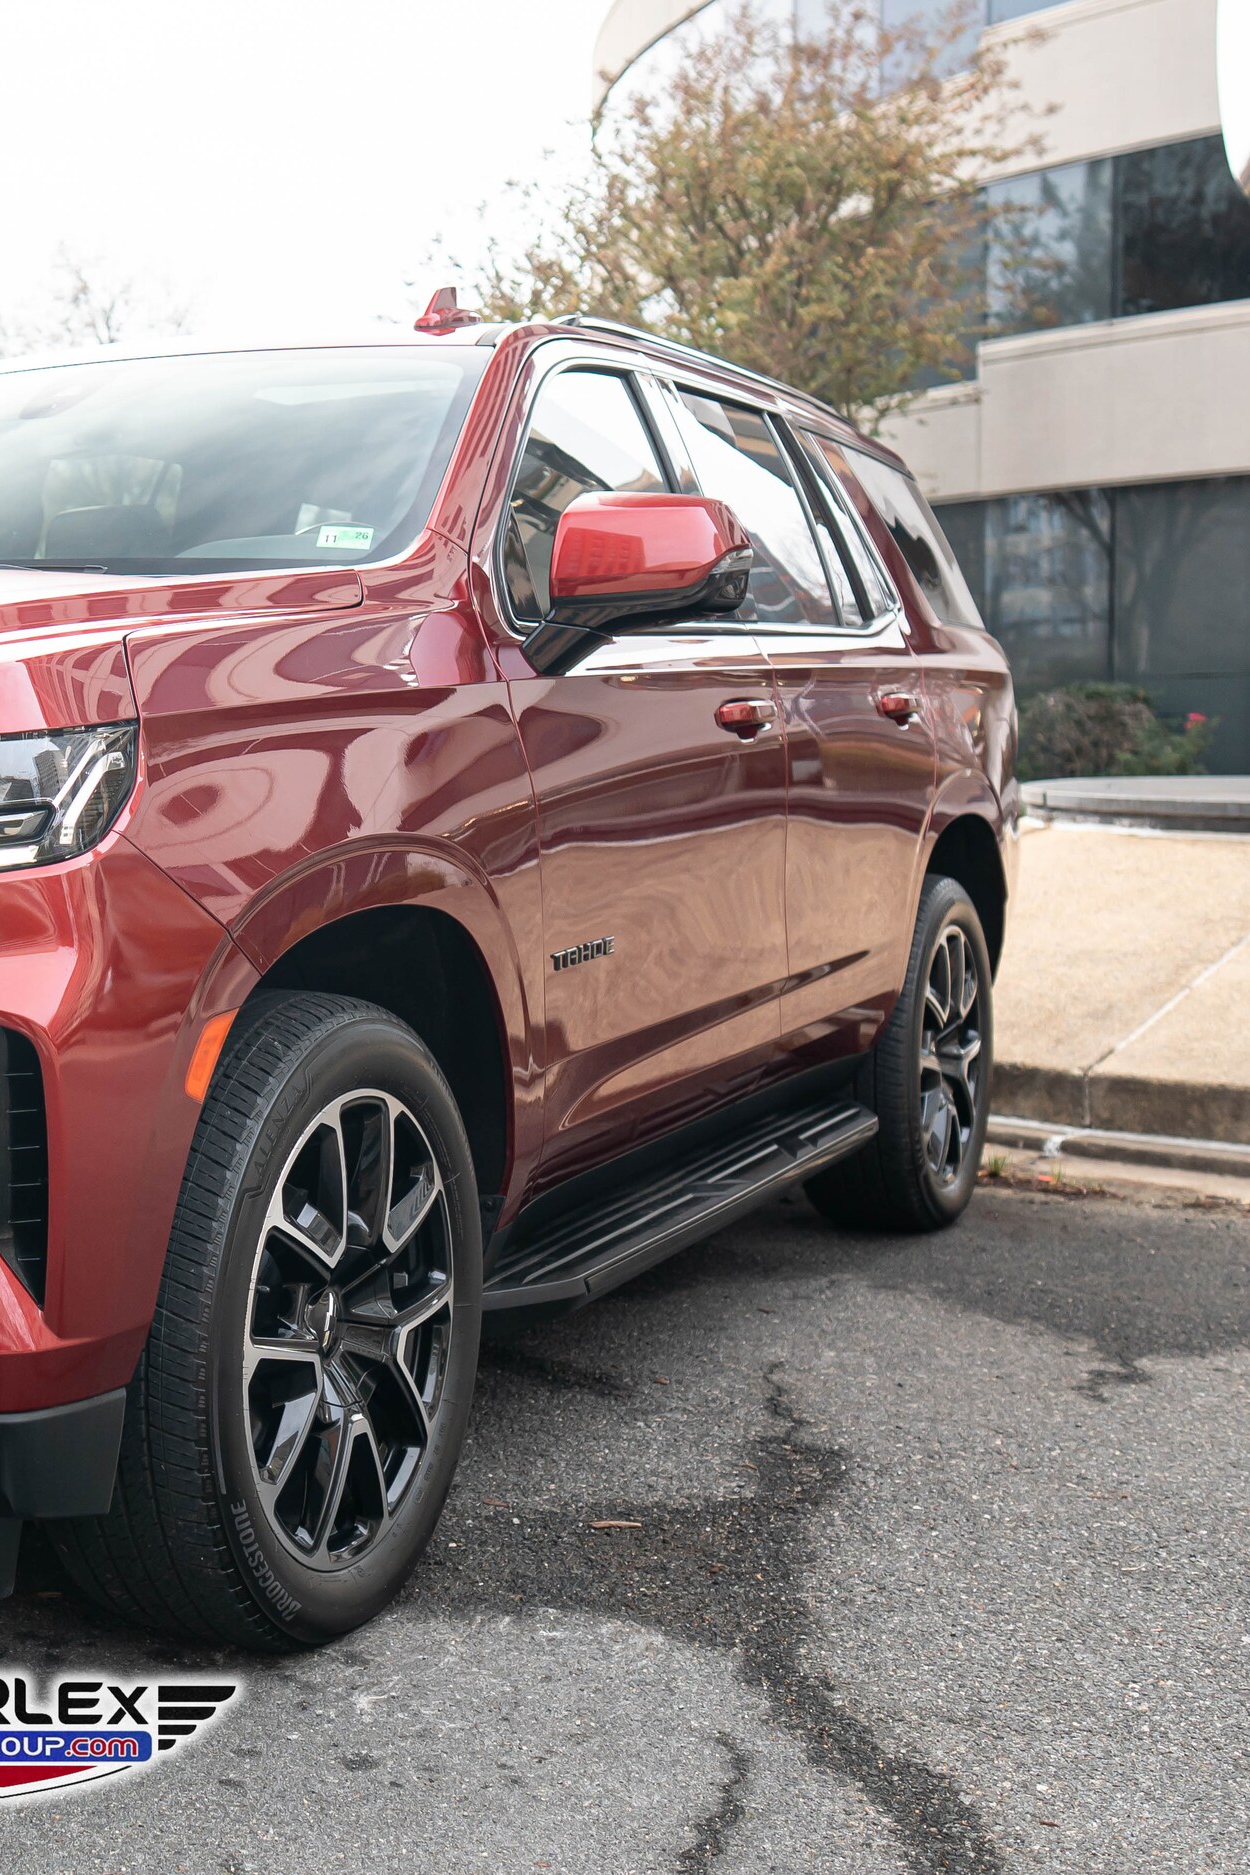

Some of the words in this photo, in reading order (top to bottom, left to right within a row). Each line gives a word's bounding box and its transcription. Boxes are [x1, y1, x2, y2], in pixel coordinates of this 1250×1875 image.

[354, 531, 369, 540] 26
[550, 936, 615, 971] TAHOE
[231, 1498, 302, 1622] BRIDGESTONE
